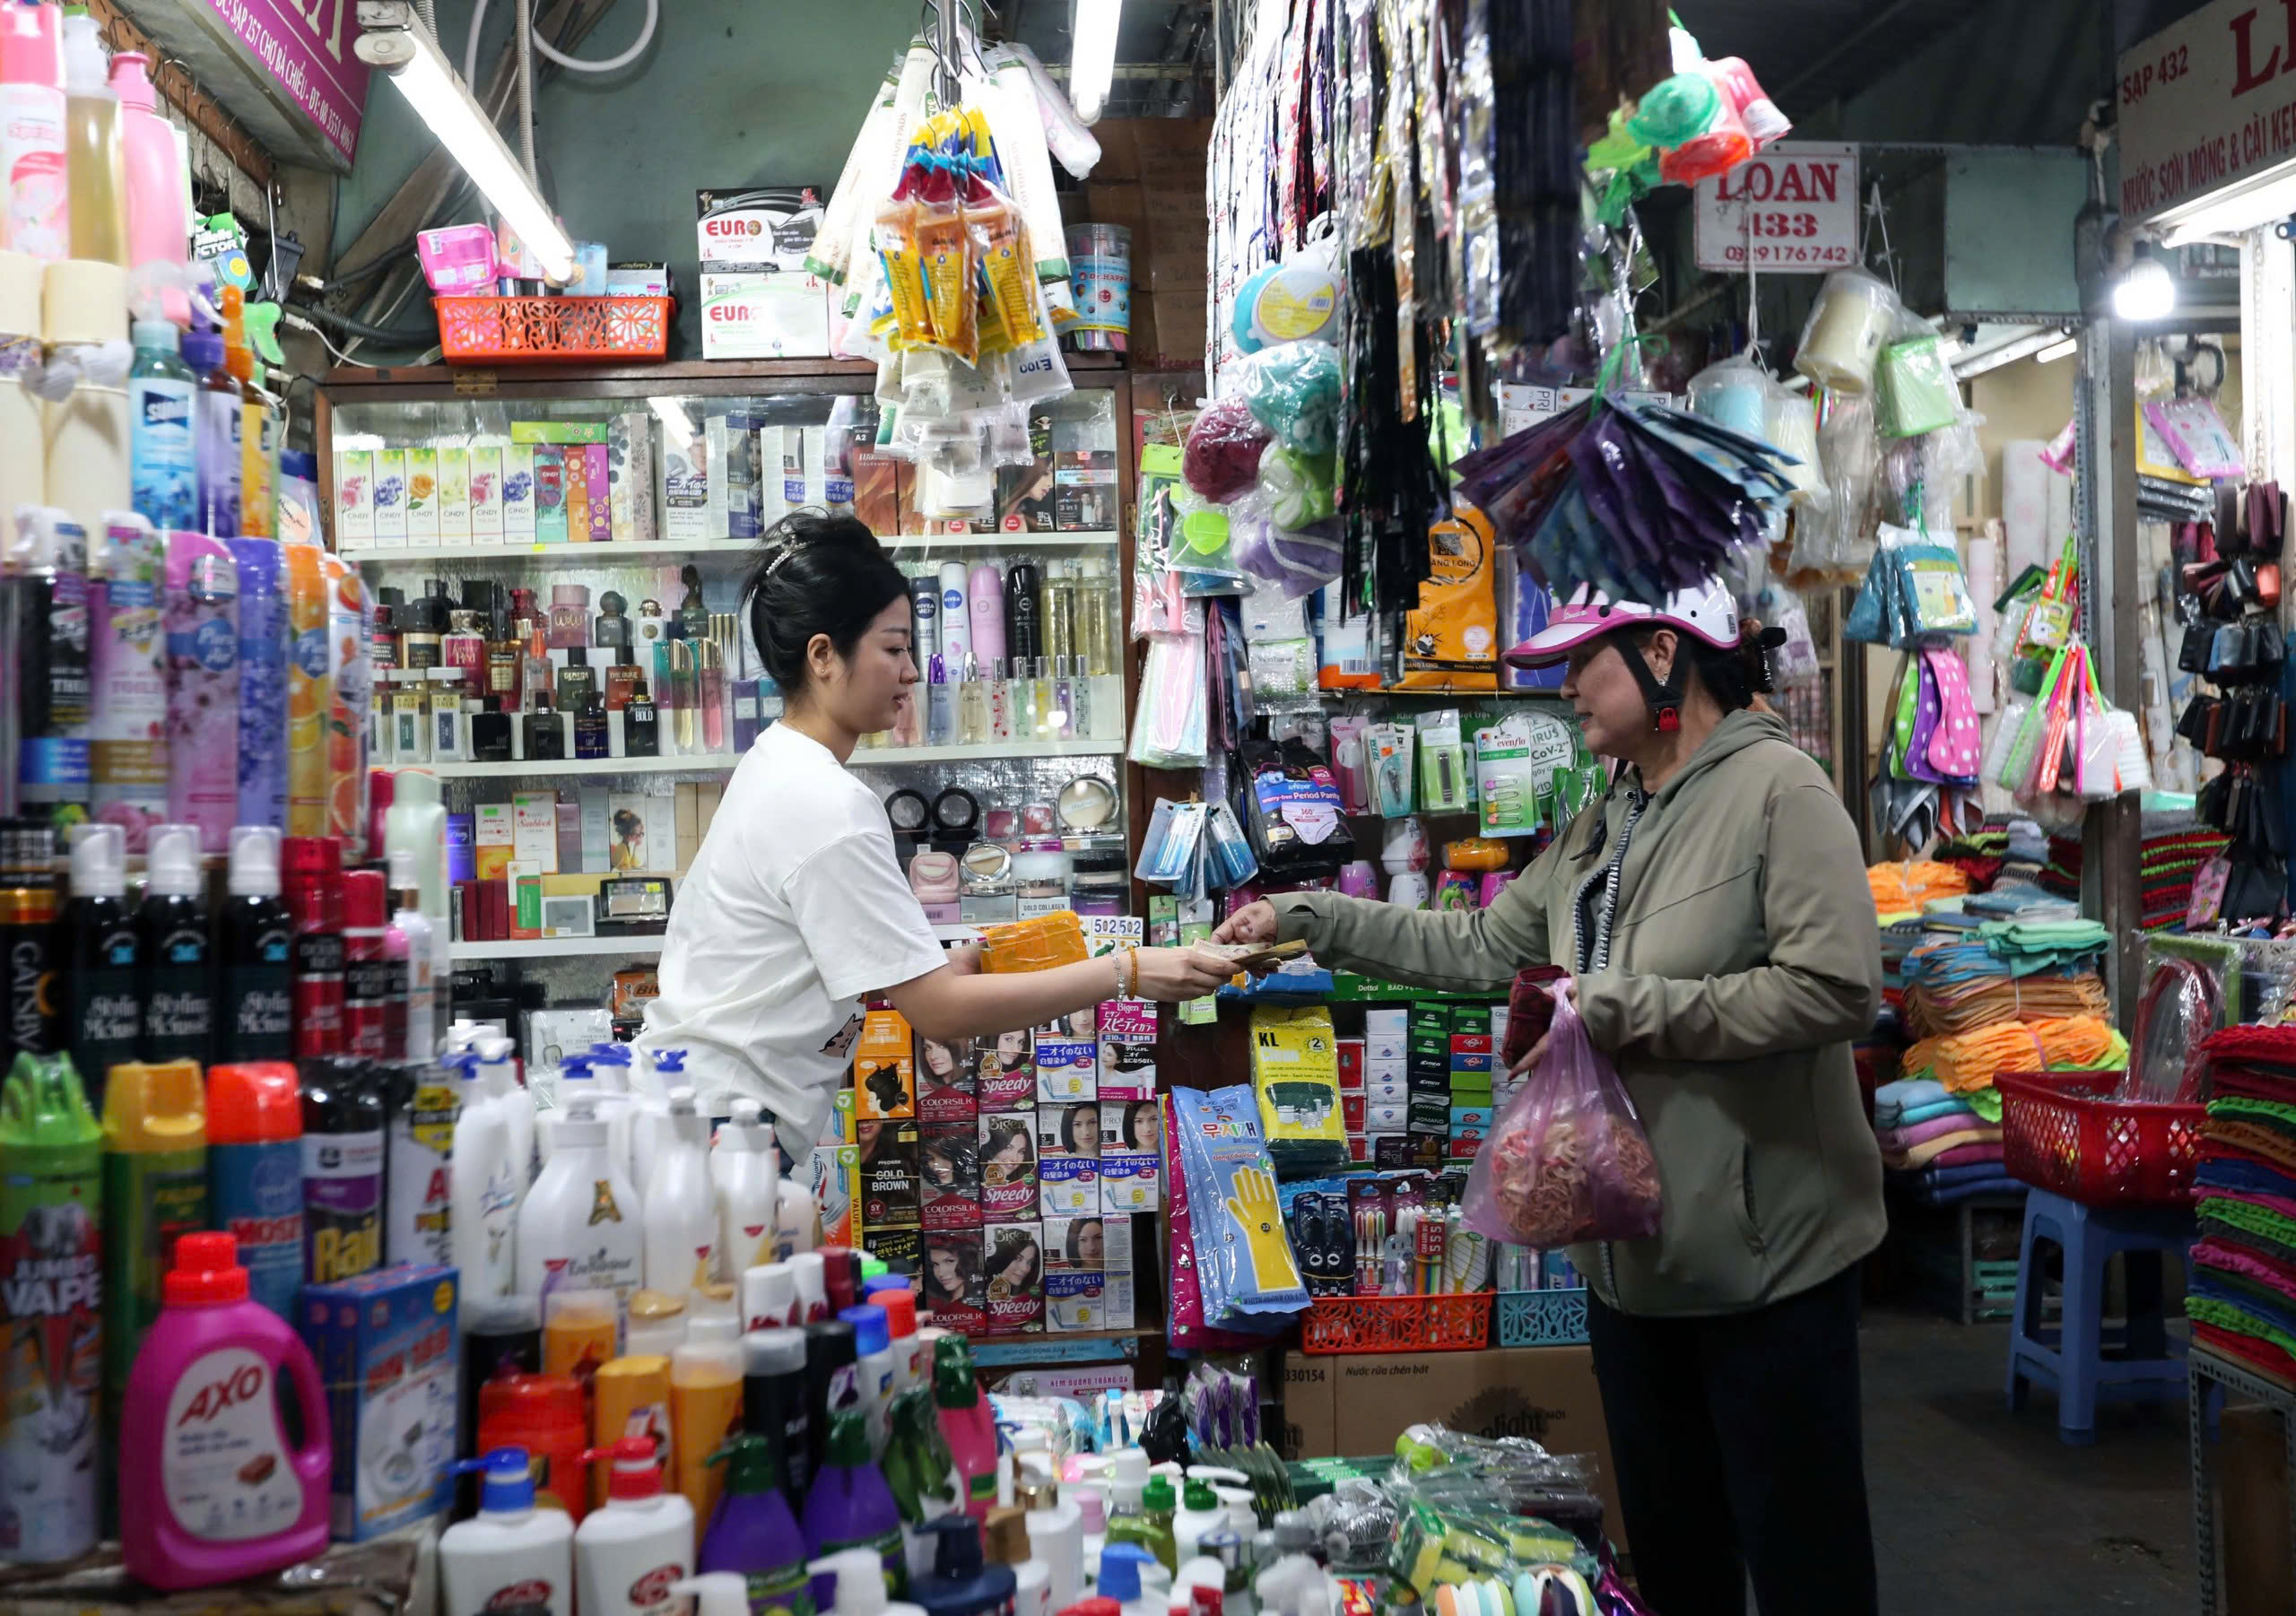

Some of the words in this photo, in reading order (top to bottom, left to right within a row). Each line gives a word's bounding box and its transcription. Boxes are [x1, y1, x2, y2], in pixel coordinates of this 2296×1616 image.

[230, 2, 248, 35] SẠP
[245, 14, 261, 47] 257
[259, 30, 278, 71] CHỢ
[320, 100, 328, 125] 08
[2123, 65, 2153, 105] SẠP
[2158, 44, 2188, 85] 432
[2123, 160, 2155, 215] NƯỚC
[2160, 151, 2184, 202] SƠN
[2187, 135, 2226, 189] MÓNG
[2231, 132, 2240, 173] &
[2243, 111, 2266, 164] CÀI
[1715, 161, 1840, 203] LOAN
[1020, 357, 1052, 373] E100
[1536, 389, 1551, 412] PR
[855, 434, 867, 442] A2
[635, 711, 653, 722] BOLD
[1532, 727, 1559, 743] IRUS
[1262, 795, 1292, 804] worry-free
[1293, 791, 1319, 801] Period
[1320, 791, 1340, 802] Panty
[1094, 918, 1118, 934] 502
[1119, 918, 1142, 934] 502
[1118, 1002, 1139, 1012] Bigen
[1258, 1032, 1279, 1047] KL
[1312, 1037, 1322, 1047] 2
[1040, 1046, 1092, 1056] ニオイのない
[981, 1077, 1033, 1094] Speedy
[920, 1097, 973, 1107] COLORSILK
[988, 1116, 1027, 1134] Bigen
[1415, 1116, 1444, 1125] ROMANO
[979, 1130, 987, 1140] 6
[1043, 1160, 1095, 1170] ニオイのない
[875, 1169, 904, 1180] GOLD
[872, 1180, 909, 1192] BROWN
[983, 1186, 1034, 1203] Speedy
[925, 1204, 977, 1214] COLORSILK
[994, 1227, 1034, 1247] Bigen
[990, 1300, 1040, 1316] Speedy
[930, 1312, 983, 1322] COLORSILK
[1345, 1365, 1370, 1377] Nước
[1373, 1365, 1388, 1377] rửa
[1389, 1364, 1412, 1375] chén
[1413, 1364, 1429, 1375] bát
[177, 1364, 263, 1428] AXO
